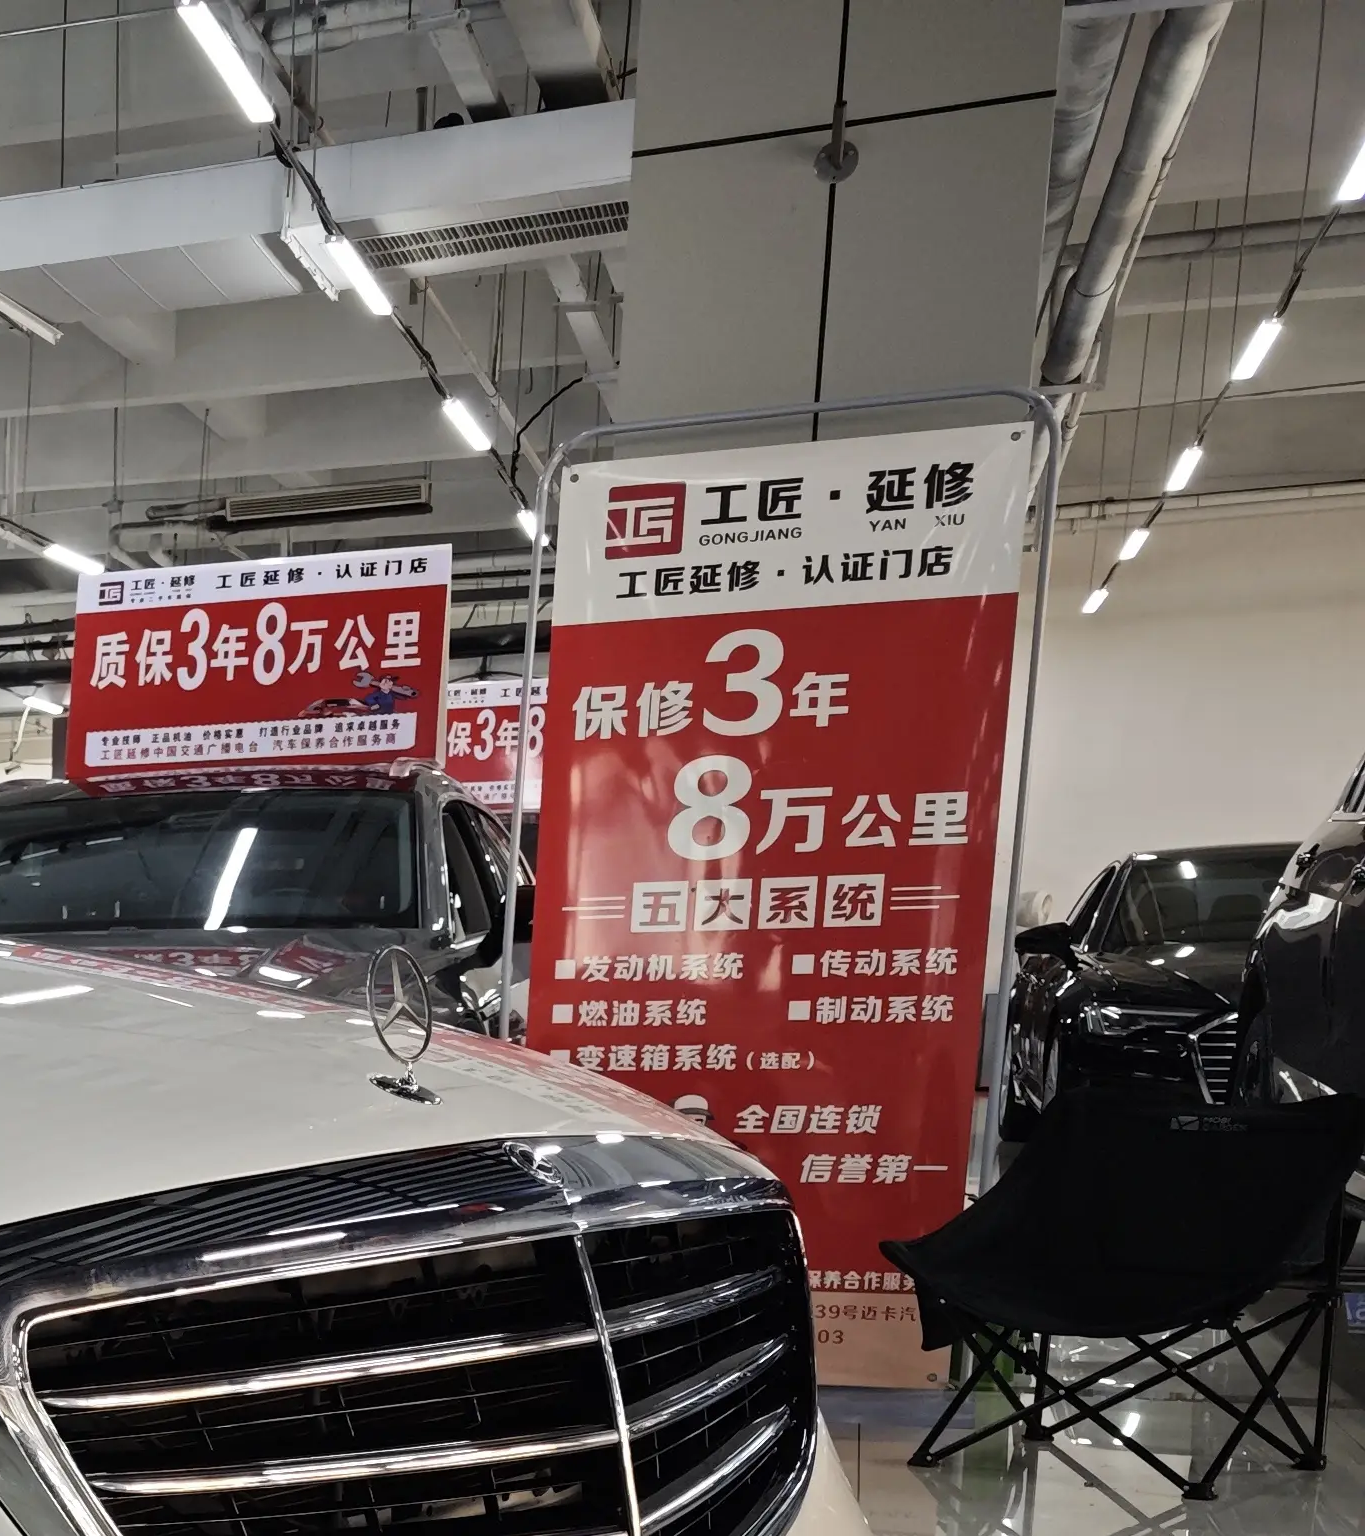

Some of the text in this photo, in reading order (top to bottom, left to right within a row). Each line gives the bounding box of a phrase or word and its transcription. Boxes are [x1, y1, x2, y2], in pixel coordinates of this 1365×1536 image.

[698, 513, 966, 547] GONGJIANG YAN XIU
[89, 601, 422, 691] 质保3年8万公里
[571, 628, 850, 741] 保修3年
[666, 753, 970, 863] 8万公里
[635, 880, 881, 930] 五大系统
[581, 946, 959, 982] 发动机系统 传动系统
[577, 994, 955, 1028] 燃油系统 制动系统
[733, 1104, 882, 1135] 全国连锁
[800, 1153, 949, 1185] 信誉第一
